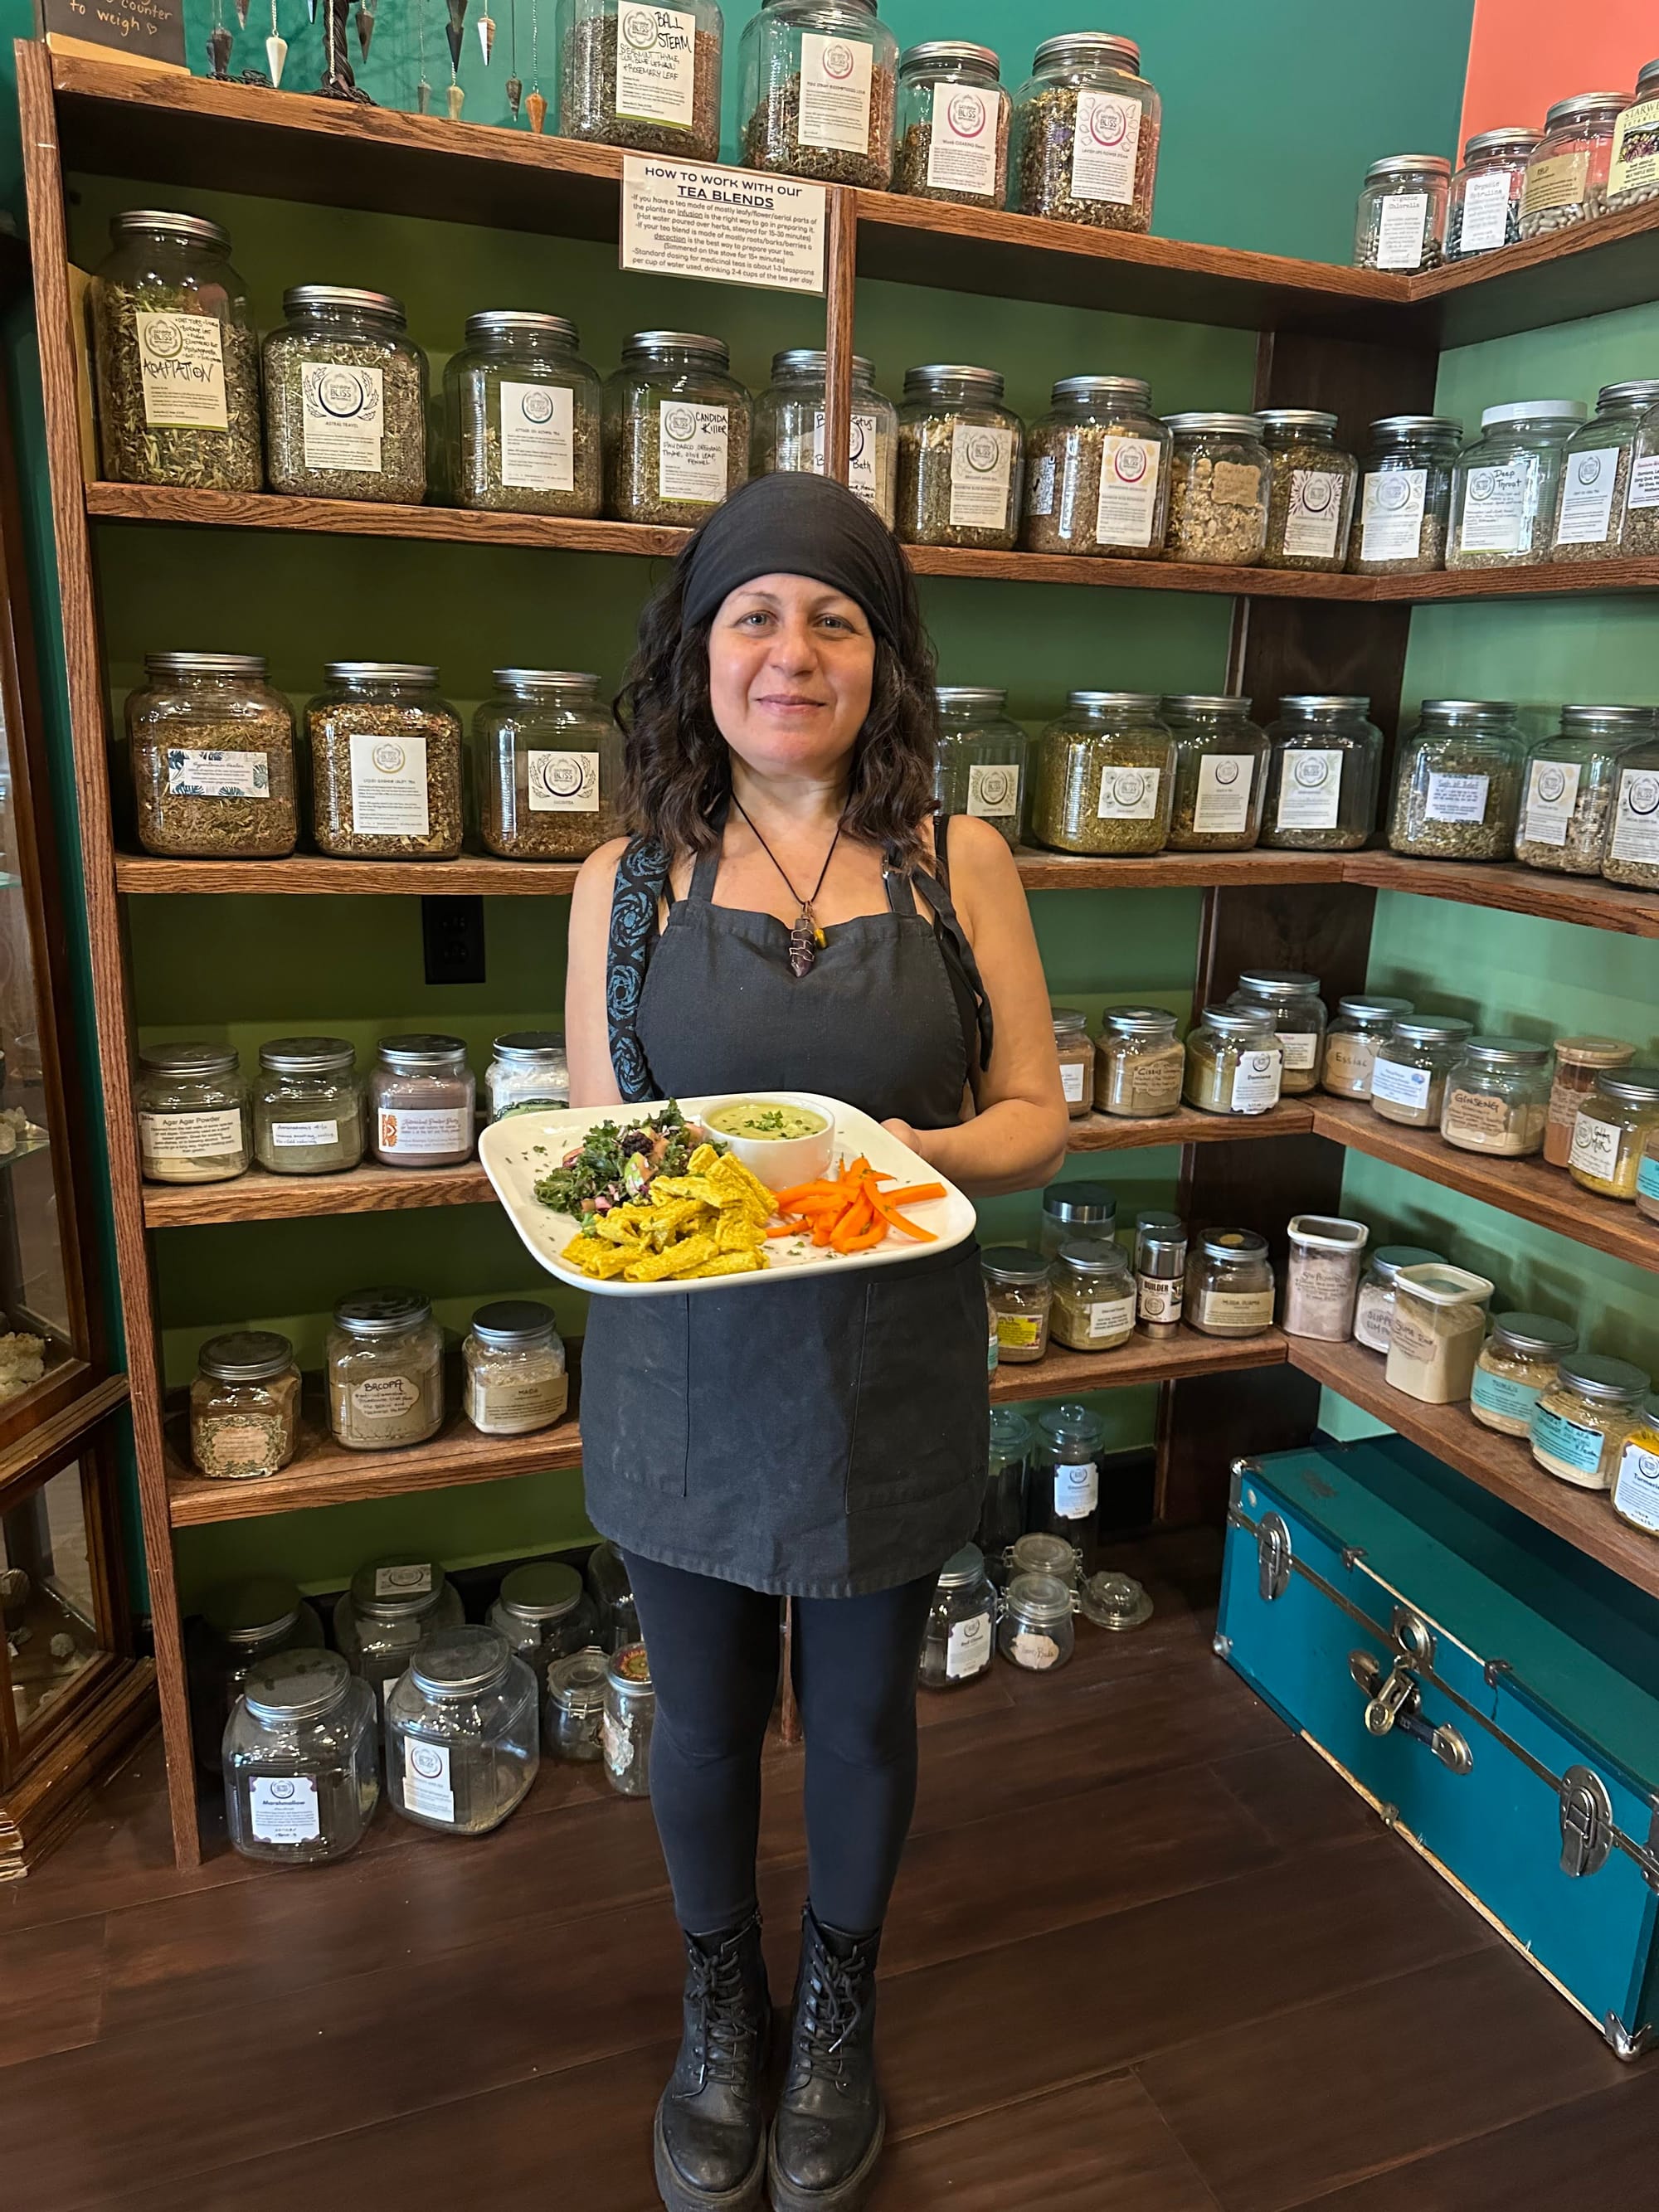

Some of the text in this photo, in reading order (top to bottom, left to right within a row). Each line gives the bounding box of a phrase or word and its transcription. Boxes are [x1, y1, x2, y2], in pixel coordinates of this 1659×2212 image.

[70, 0, 140, 36] to weigh
[654, 12, 684, 30] BALL
[657, 33, 692, 53] STEAM
[645, 167, 677, 179] HOW
[679, 172, 697, 182] TO
[742, 181, 773, 193] WITH
[677, 185, 774, 208] TEA BLENDS
[645, 205, 666, 213] plants
[722, 215, 737, 223] right
[776, 223, 807, 233] preparing
[652, 196, 669, 205] have
[714, 206, 734, 214] mostly
[736, 208, 791, 221] leafy/flower/aerial
[654, 232, 686, 243] decoction
[705, 238, 719, 246] best
[671, 225, 689, 234] blend
[724, 234, 745, 242] mostly
[747, 236, 806, 250] roots/barks/berries
[732, 226, 757, 234] steeped
[768, 229, 784, 237] 15-30
[666, 251, 688, 261] dosing
[700, 257, 730, 265] medicinal
[752, 262, 771, 270] about
[782, 266, 814, 275] teaspoons
[703, 265, 730, 275] drinking
[143, 358, 214, 382] ADAPTATION
[696, 411, 728, 424] CANDIDA
[1494, 469, 1515, 479] Deep
[1368, 1310, 1393, 1326] SLIPPE
